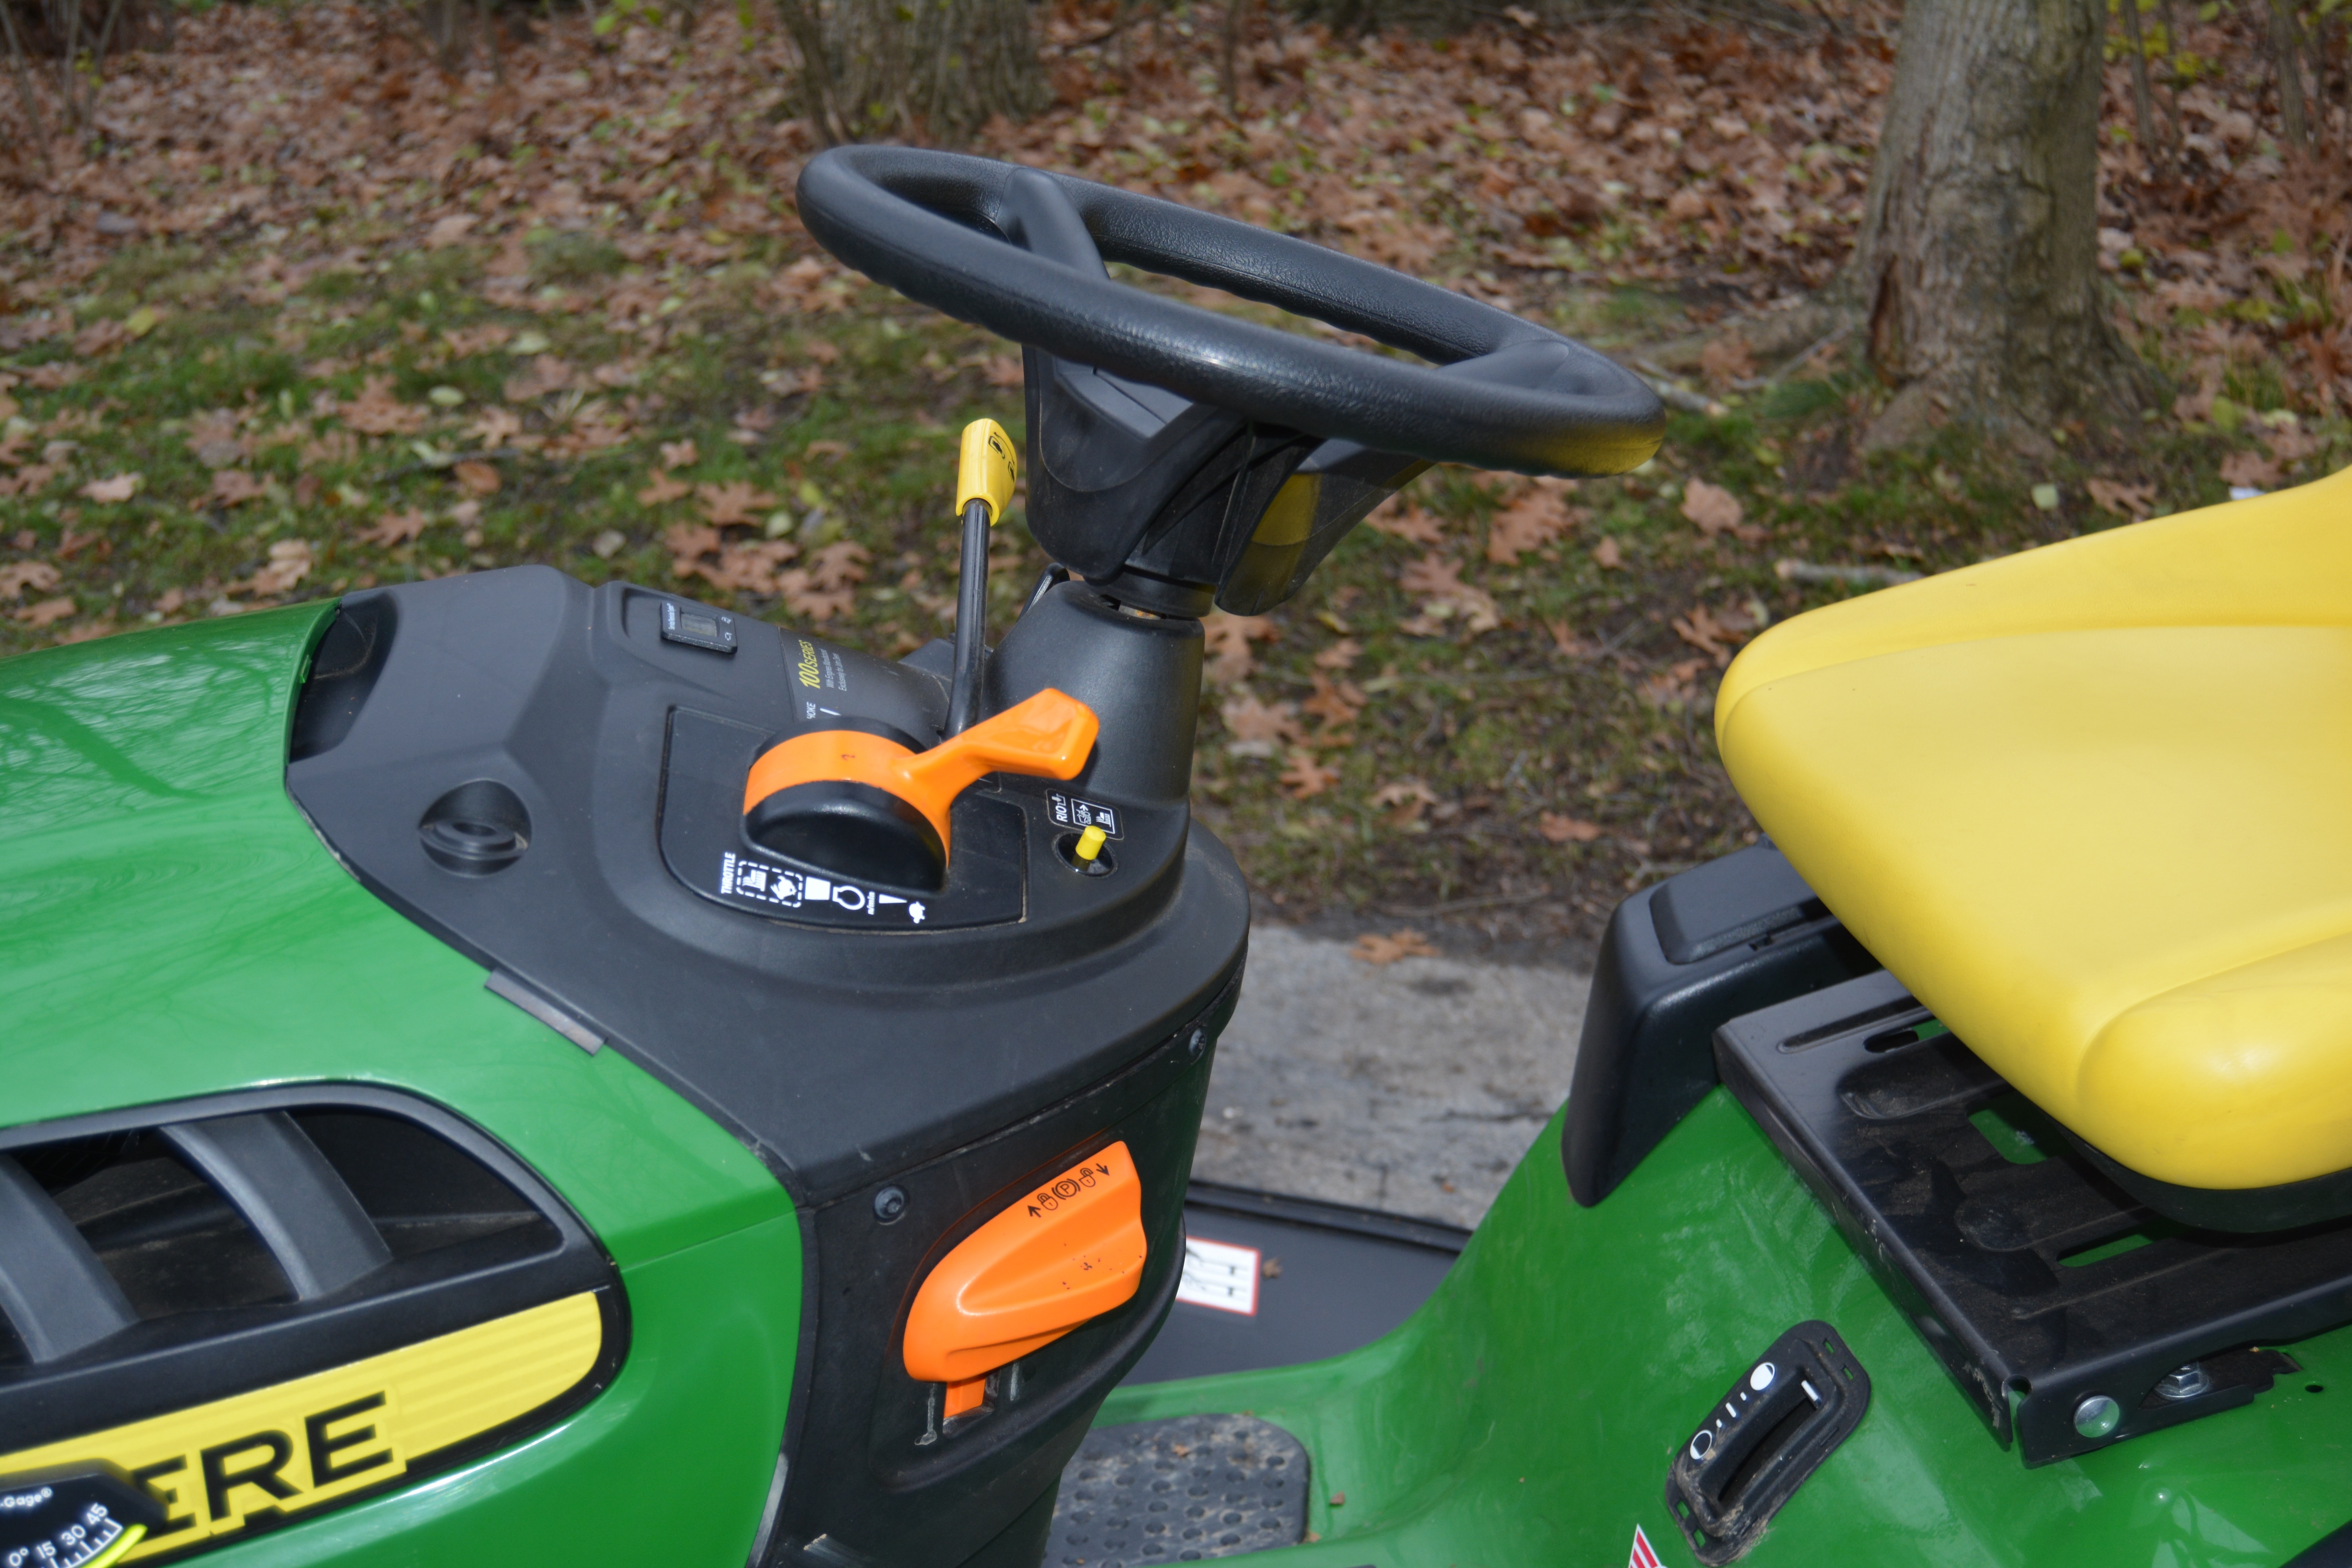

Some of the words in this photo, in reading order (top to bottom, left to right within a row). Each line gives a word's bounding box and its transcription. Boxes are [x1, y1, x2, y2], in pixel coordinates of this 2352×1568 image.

[798, 639, 818, 667] SERIES
[798, 662, 820, 689] 100
[1055, 805, 1068, 822] RIO
[721, 852, 736, 894] THROTTLE
[867, 891, 875, 915] n/min
[9, 1548, 28, 1566] 0°
[36, 1541, 56, 1558] 15
[61, 1525, 85, 1545] 30
[86, 1503, 107, 1524] 45
